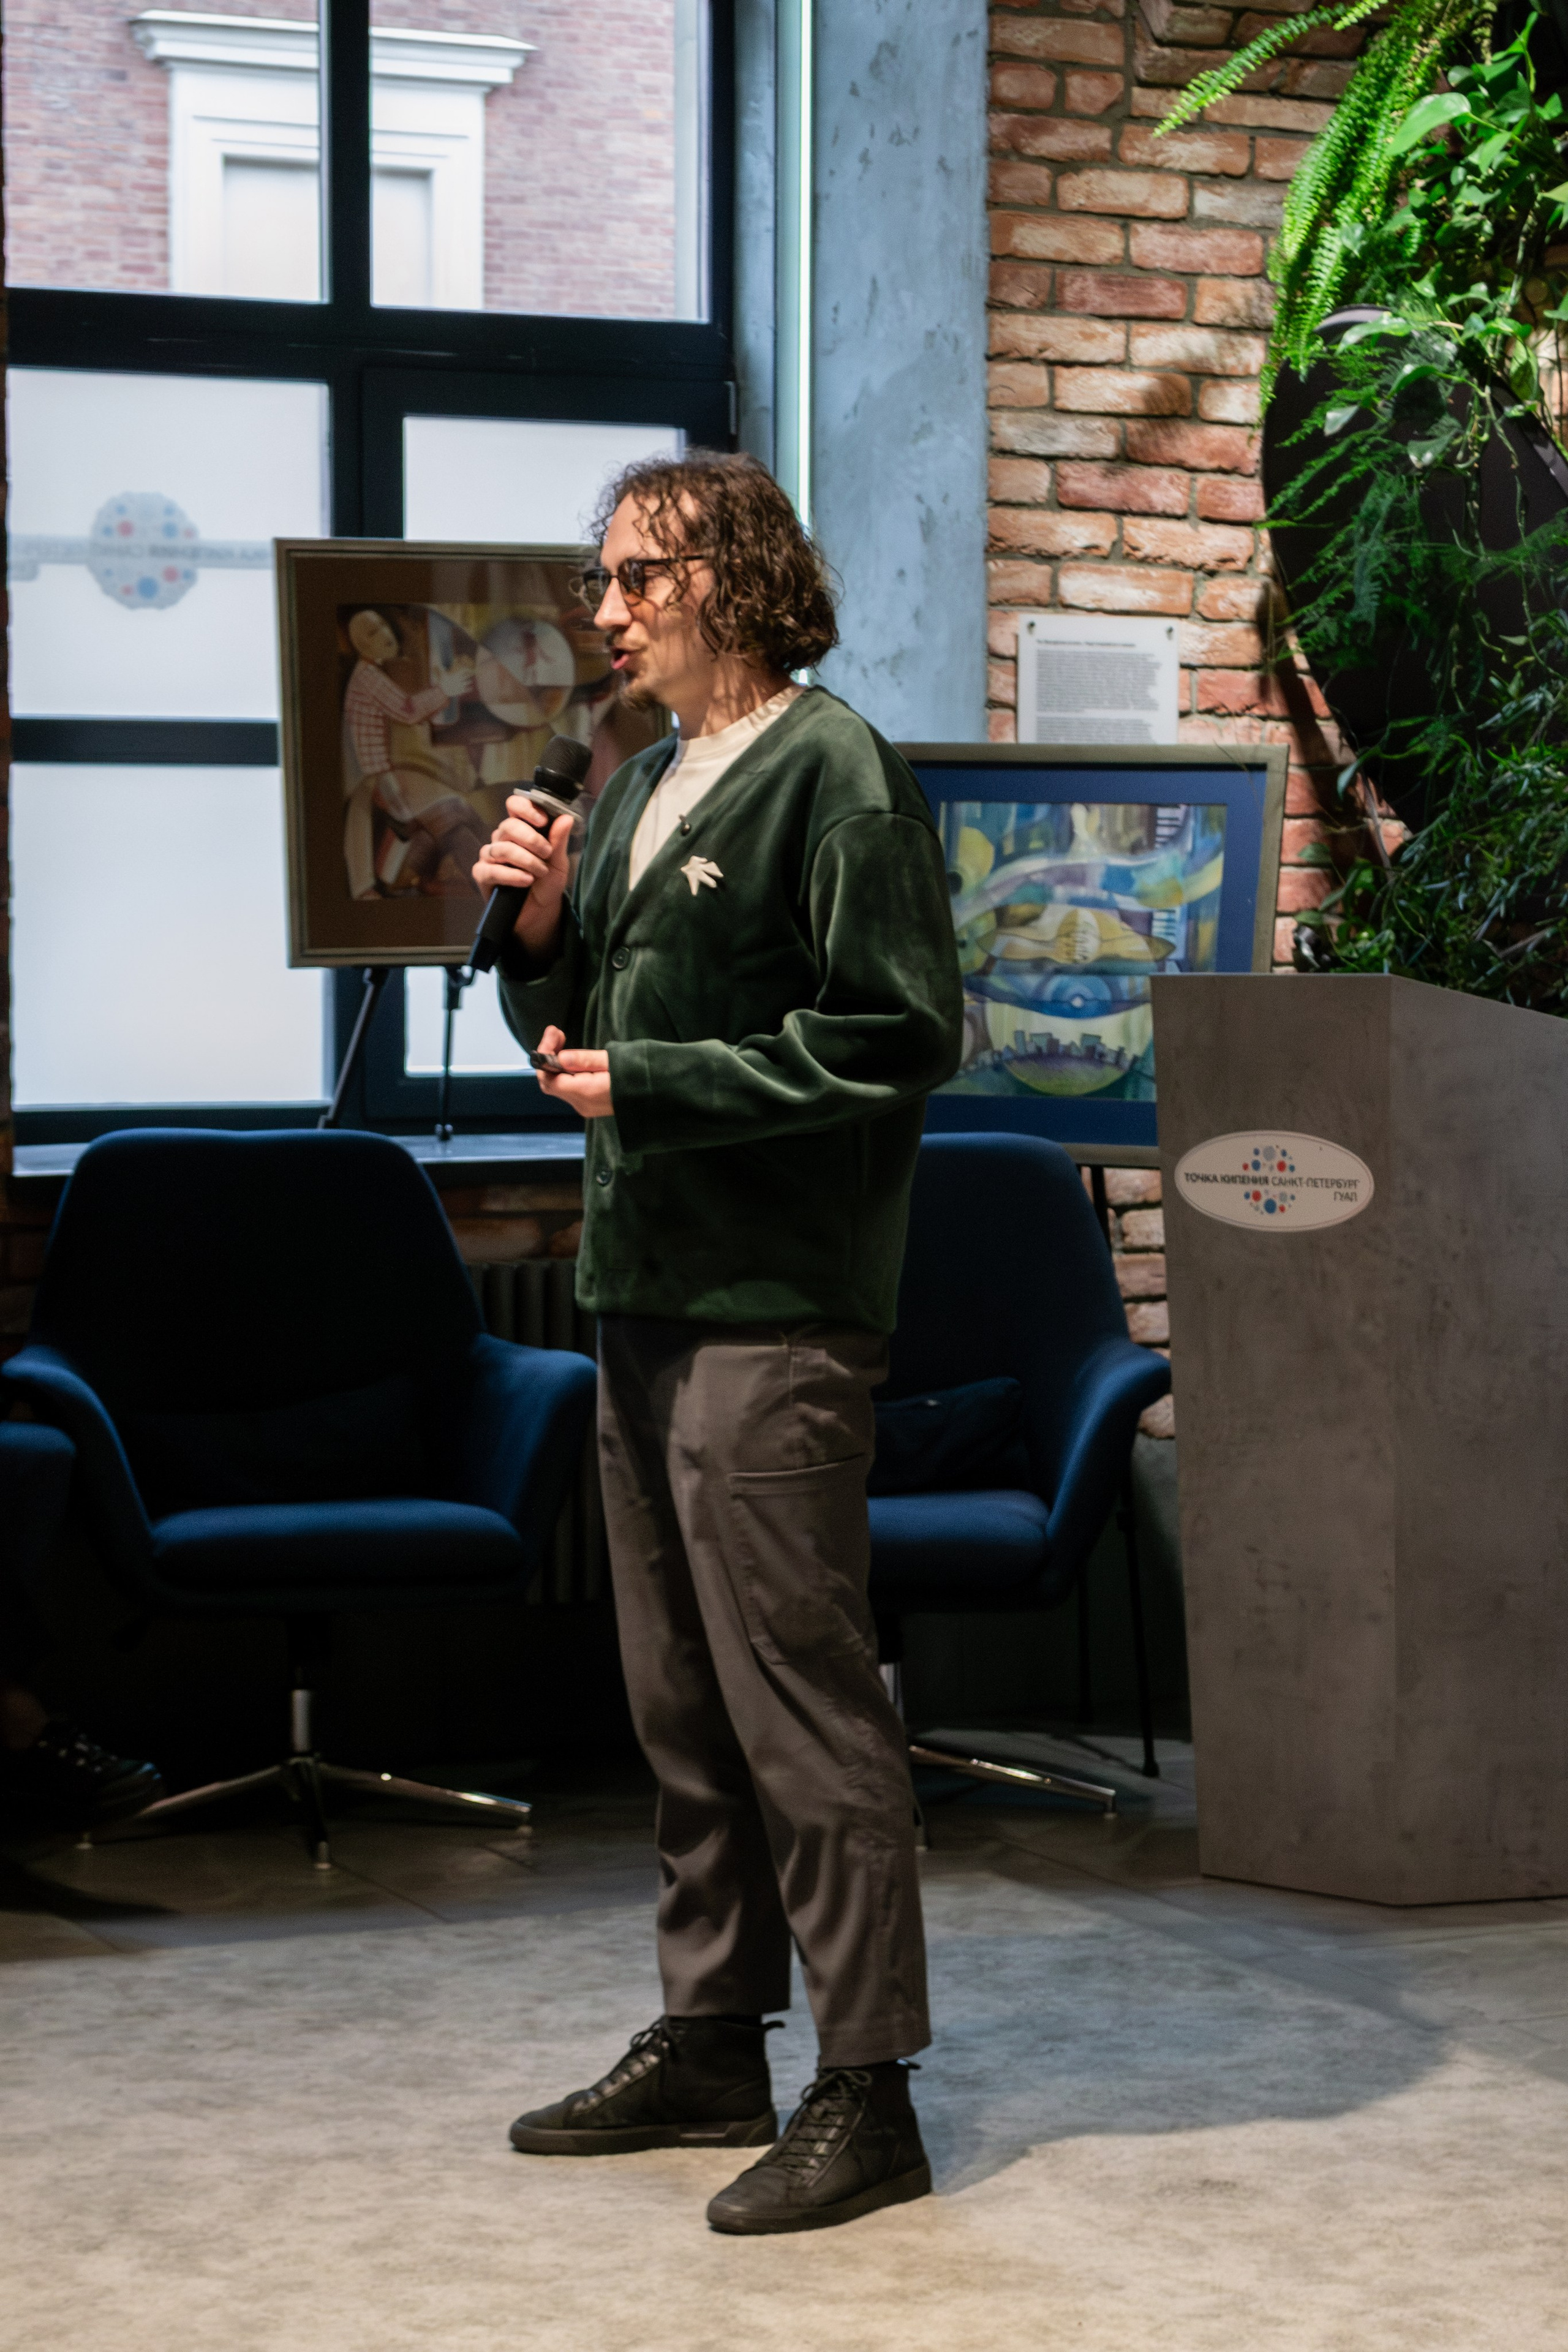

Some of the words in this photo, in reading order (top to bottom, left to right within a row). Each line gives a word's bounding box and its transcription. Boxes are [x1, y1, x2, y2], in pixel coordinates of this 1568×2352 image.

[1184, 1172, 1218, 1184] ТОЧКА
[1221, 1174, 1269, 1186] КИПЕНИЯ
[1272, 1176, 1359, 1189] САНКТ-ПЕТЕРБУРГ
[1333, 1192, 1357, 1202] ГУАП
